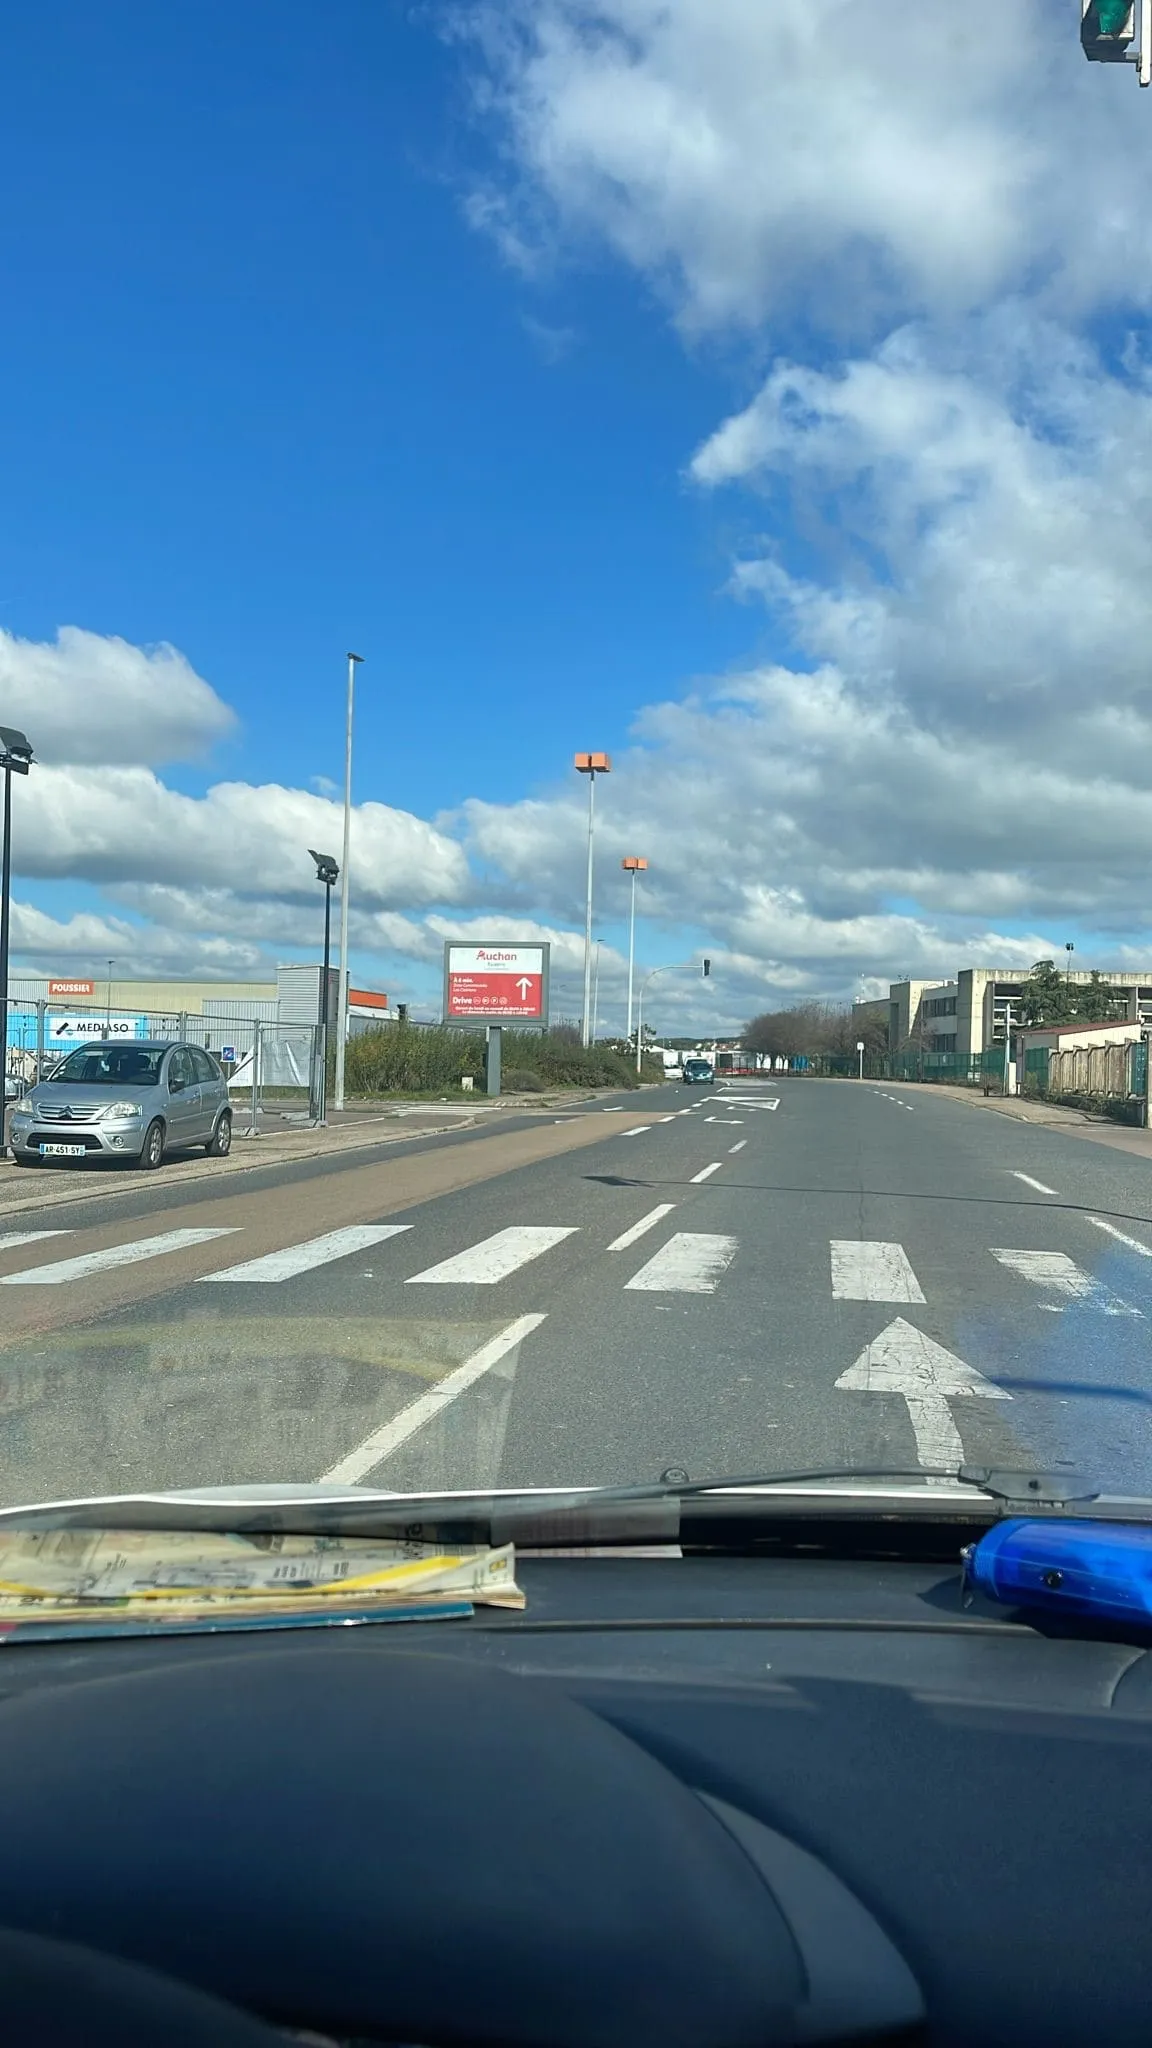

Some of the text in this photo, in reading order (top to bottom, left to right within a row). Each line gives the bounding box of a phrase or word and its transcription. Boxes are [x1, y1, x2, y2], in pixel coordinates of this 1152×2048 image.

[476, 950, 517, 960] Auchan
[52, 983, 90, 993] FOUSSIER
[453, 996, 472, 1004] Drive
[76, 1023, 129, 1033] MEDIASO
